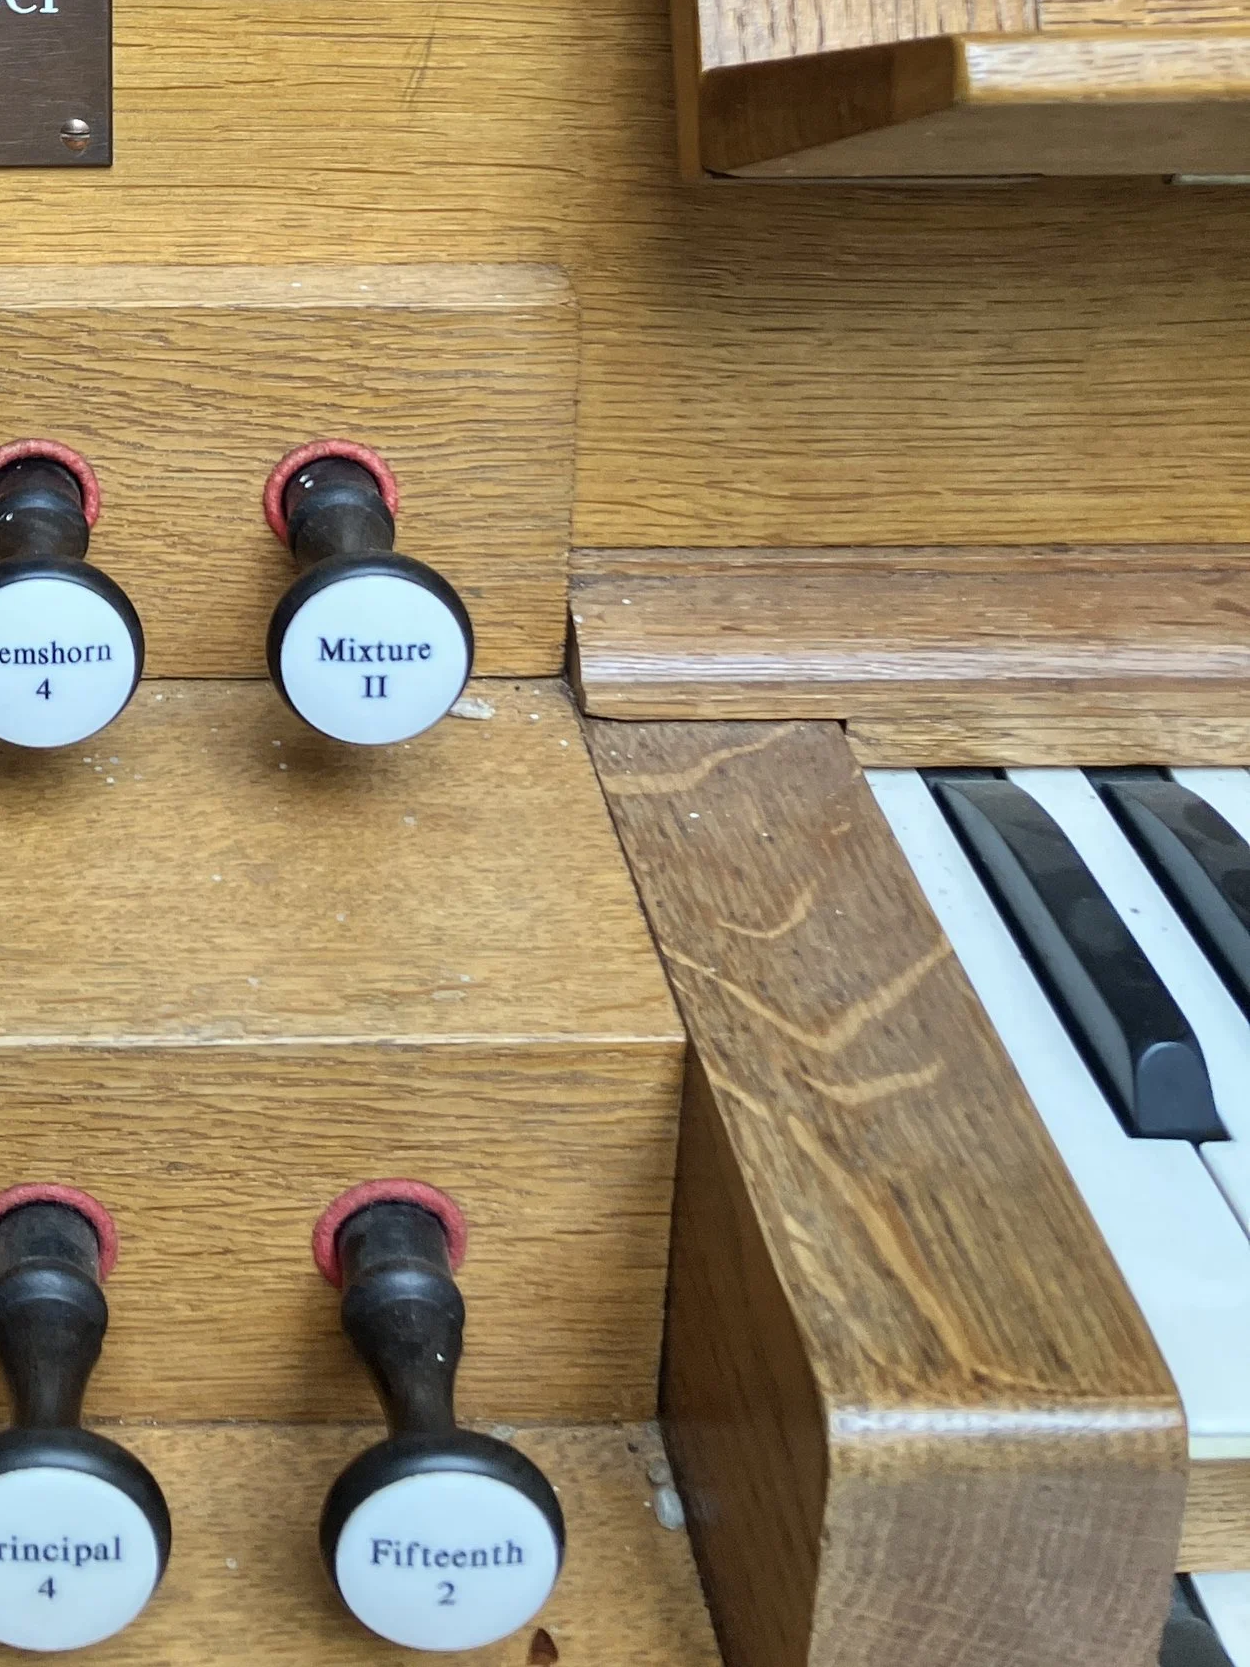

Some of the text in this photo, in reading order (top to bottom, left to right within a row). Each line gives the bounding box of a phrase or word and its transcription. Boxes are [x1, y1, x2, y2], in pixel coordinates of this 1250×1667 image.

[319, 637, 431, 663] Mixture
[35, 678, 52, 700] 4
[364, 675, 387, 699] II
[369, 1538, 524, 1569] Fifteenth
[37, 1577, 56, 1599] 4
[437, 1580, 456, 1607] 2
